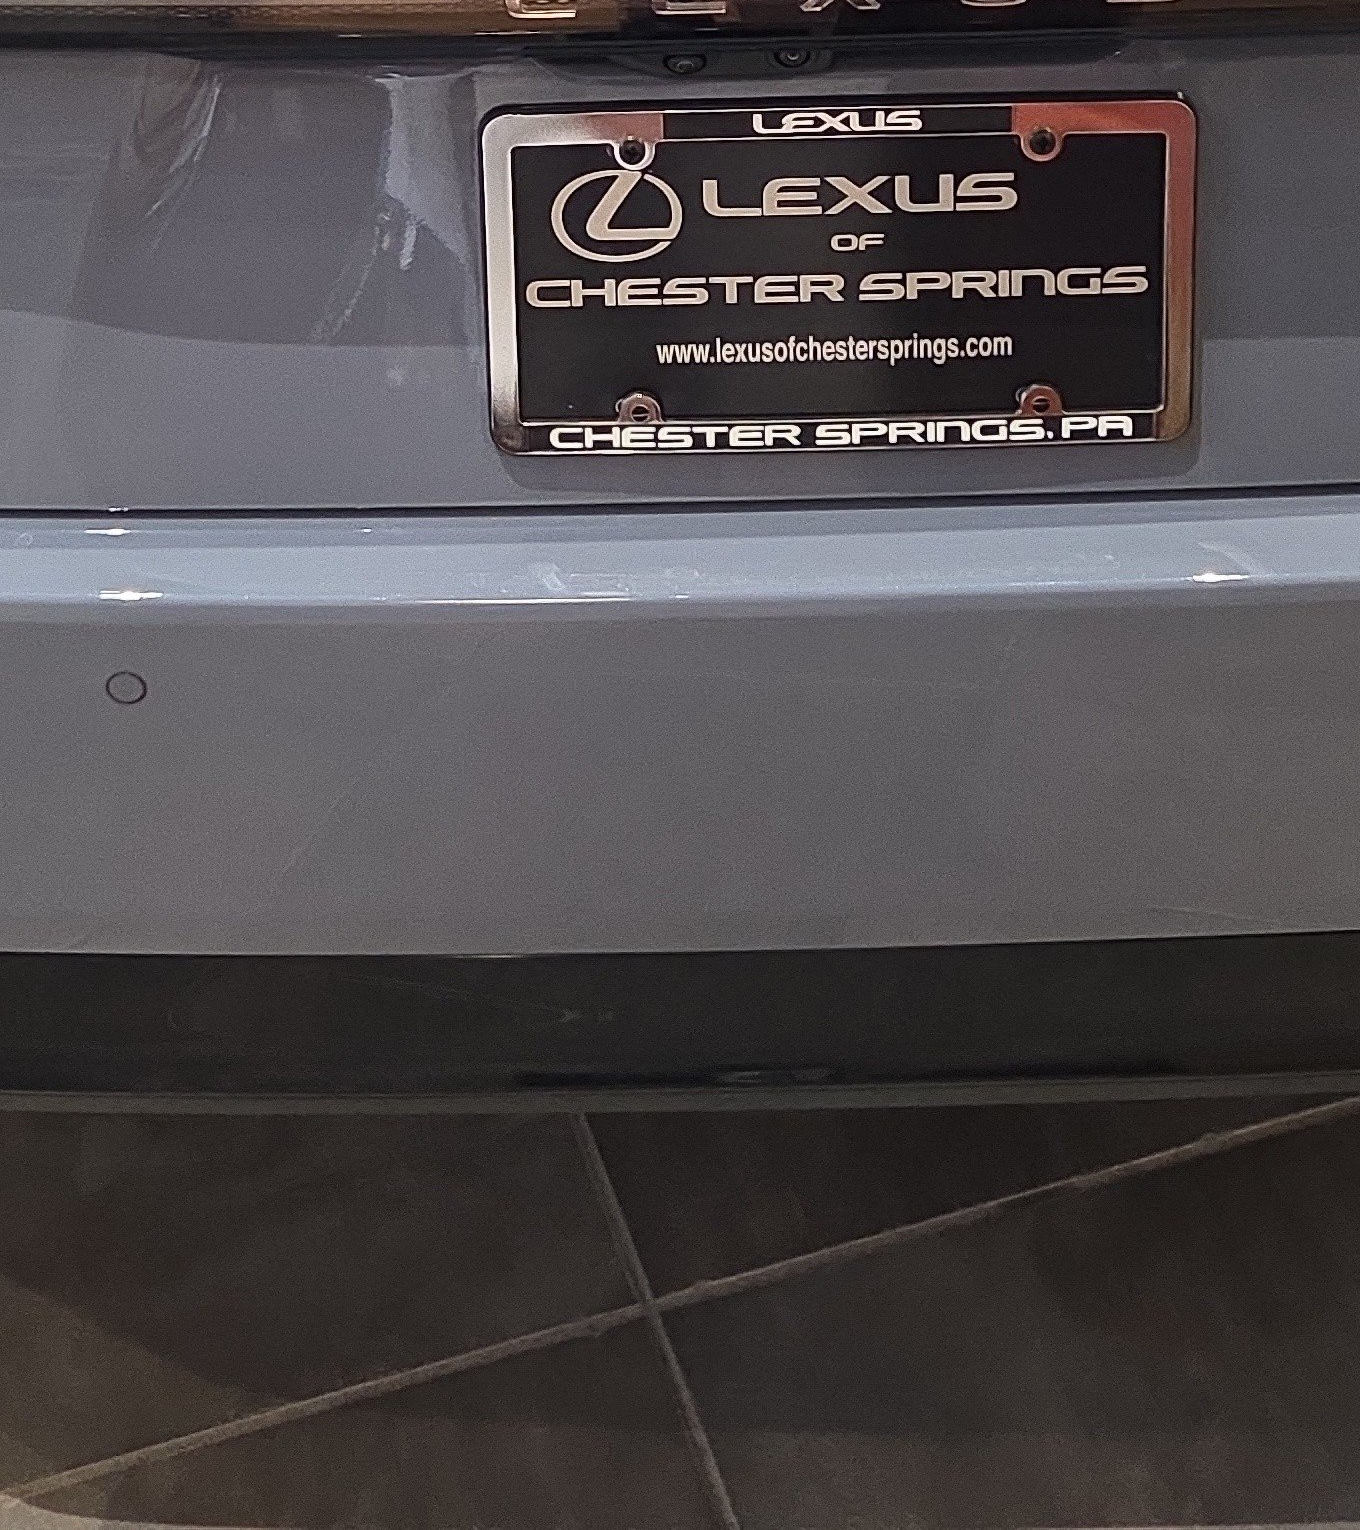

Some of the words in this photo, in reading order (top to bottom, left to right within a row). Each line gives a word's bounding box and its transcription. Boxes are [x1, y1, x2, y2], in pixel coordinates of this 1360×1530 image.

[752, 110, 923, 135] LEXUS
[702, 172, 1019, 217] LEXUS
[830, 233, 885, 252] OF
[525, 274, 845, 308] CHESTER
[858, 265, 1150, 302] SPRINGS
[656, 333, 1014, 367] www.lexusofchestersprings.com
[549, 423, 802, 450] CHESTER
[1060, 415, 1134, 440] PA
